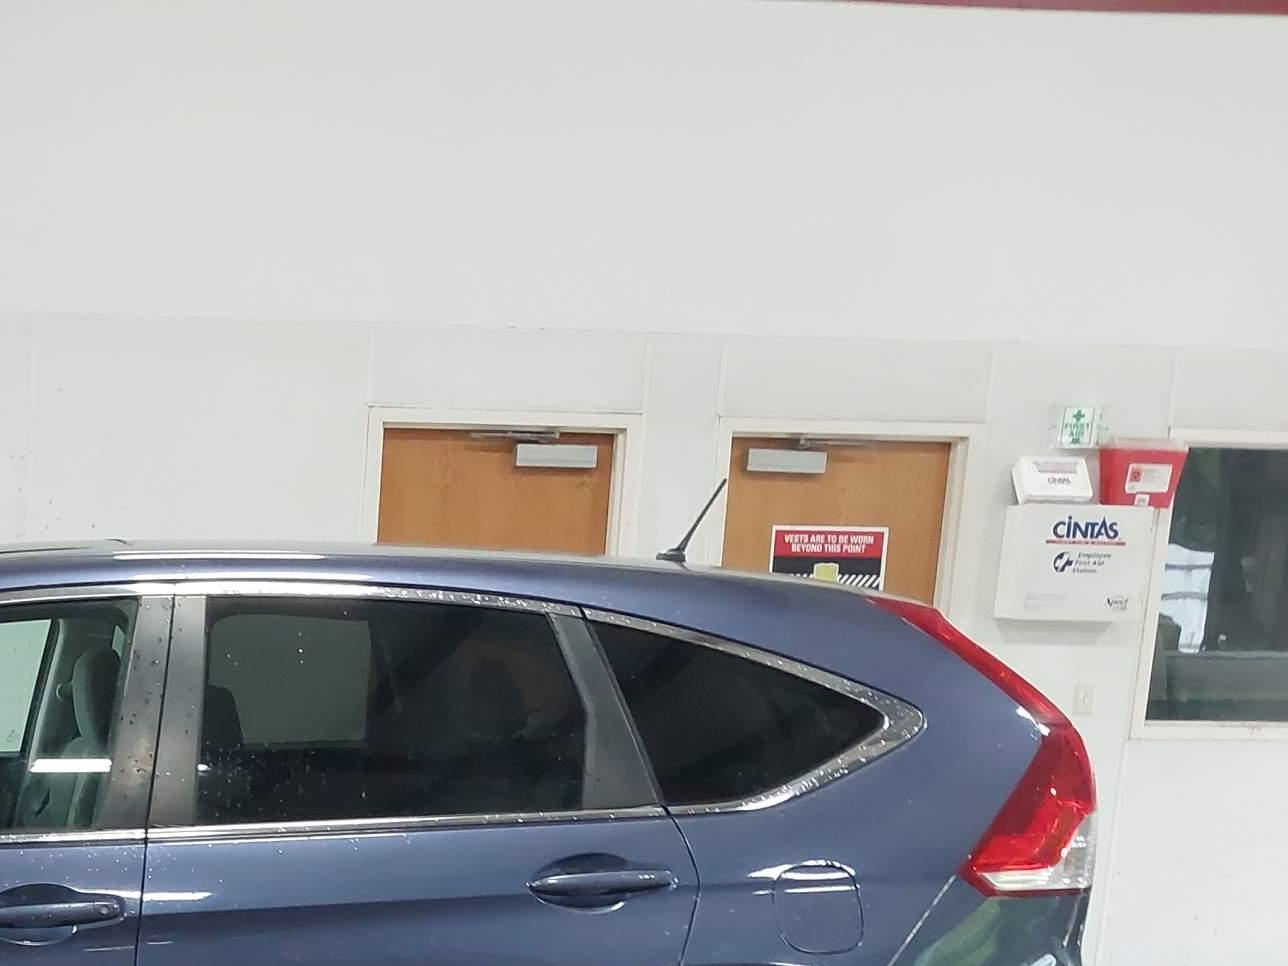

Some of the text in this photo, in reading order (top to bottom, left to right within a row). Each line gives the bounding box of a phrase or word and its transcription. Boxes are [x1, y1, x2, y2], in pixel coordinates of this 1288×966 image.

[1064, 423, 1089, 431] FIRST
[784, 533, 875, 545] VESTS ARE TO BE WORN
[791, 543, 867, 554] BEYOND THIS POINT
